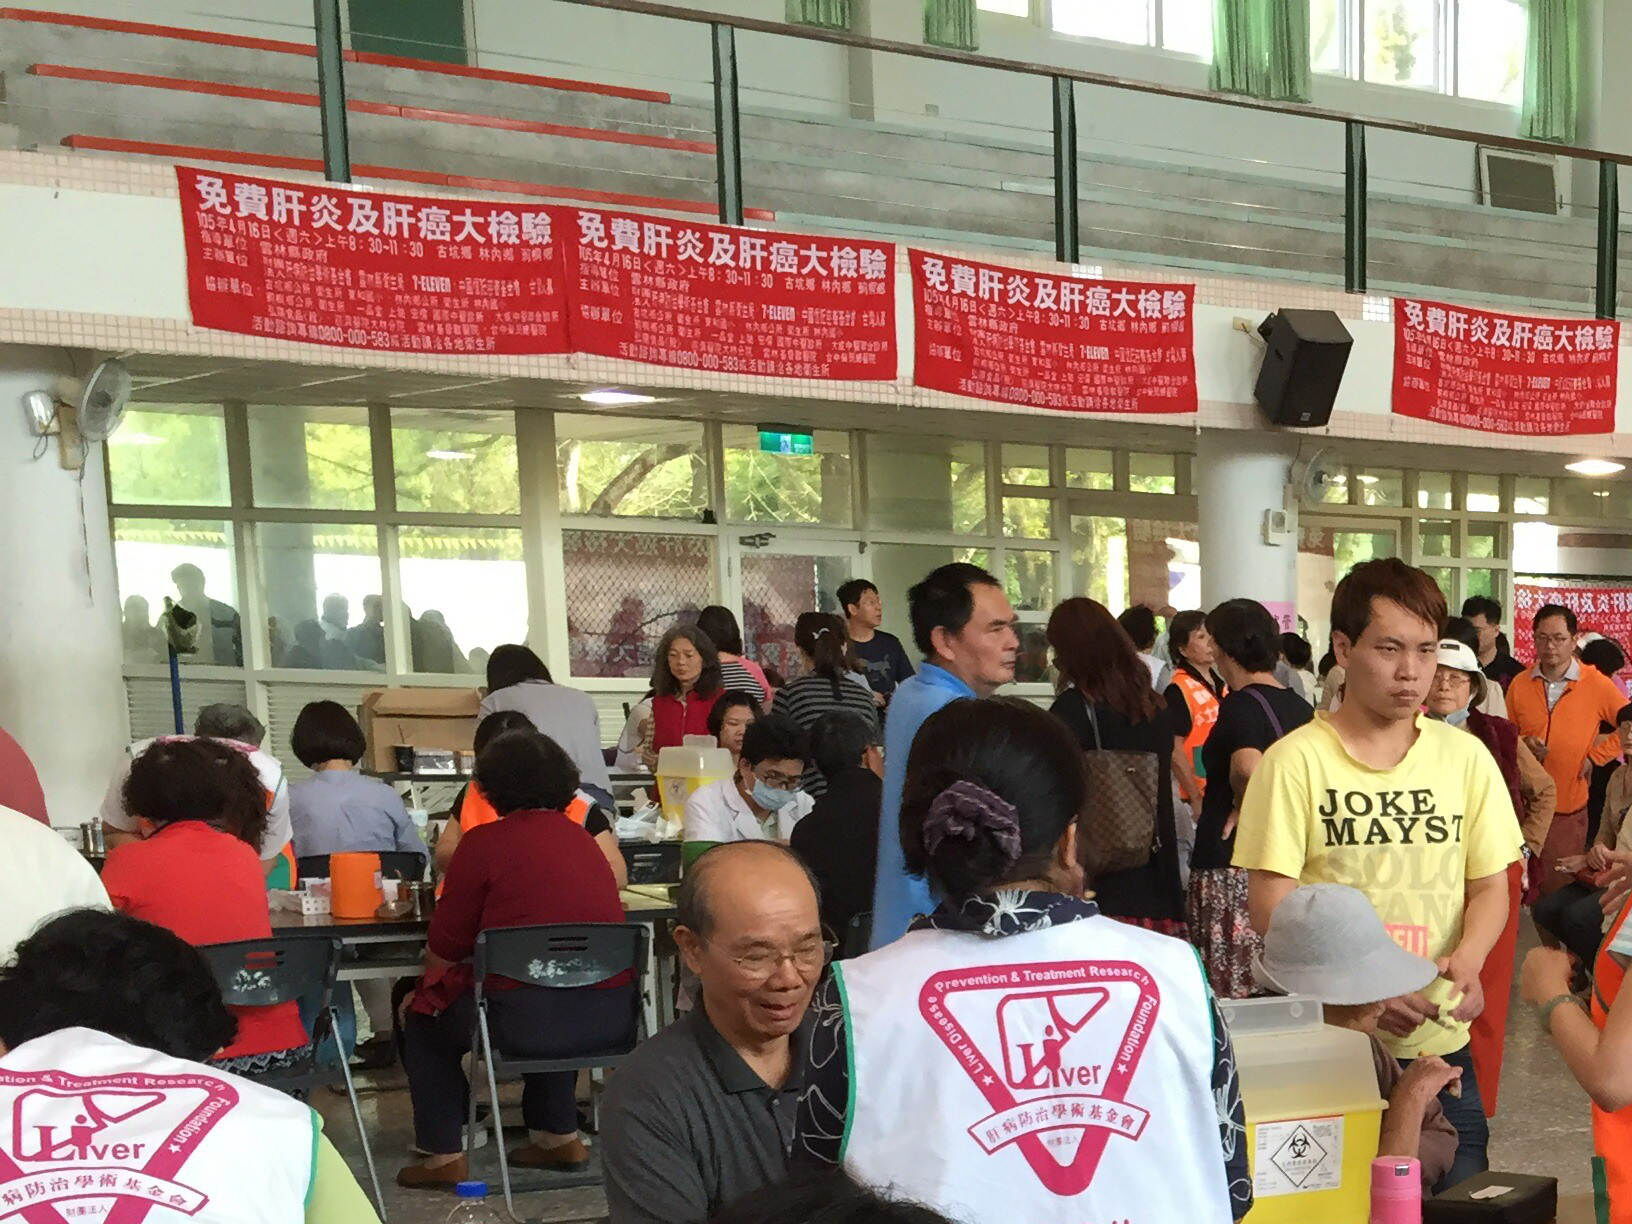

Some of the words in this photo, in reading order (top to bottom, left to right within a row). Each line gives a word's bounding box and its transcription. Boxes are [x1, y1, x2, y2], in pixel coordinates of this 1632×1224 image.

[195, 174, 552, 246] 免費肝炎及肝癌大檢驗
[577, 211, 887, 280] 免費肝炎及肝癌大檢驗
[922, 256, 1186, 320] 免費肝炎及肝癌大檢驗
[1403, 300, 1615, 352] 免費肝炎及肝癌大檢驗
[1319, 789, 1436, 817] JOKE
[934, 973, 1008, 993] Prevention
[1010, 971, 1020, 983] &
[1023, 968, 1086, 983] Treatment
[1089, 965, 1149, 987] Research
[928, 996, 963, 1043] Disease
[1119, 994, 1158, 1063] Foundation
[956, 1040, 983, 1075] Liver
[40, 1073, 54, 1086] &
[59, 1075, 138, 1089] Treatment
[144, 1075, 227, 1097] Research
[175, 1096, 231, 1151] Foundation
